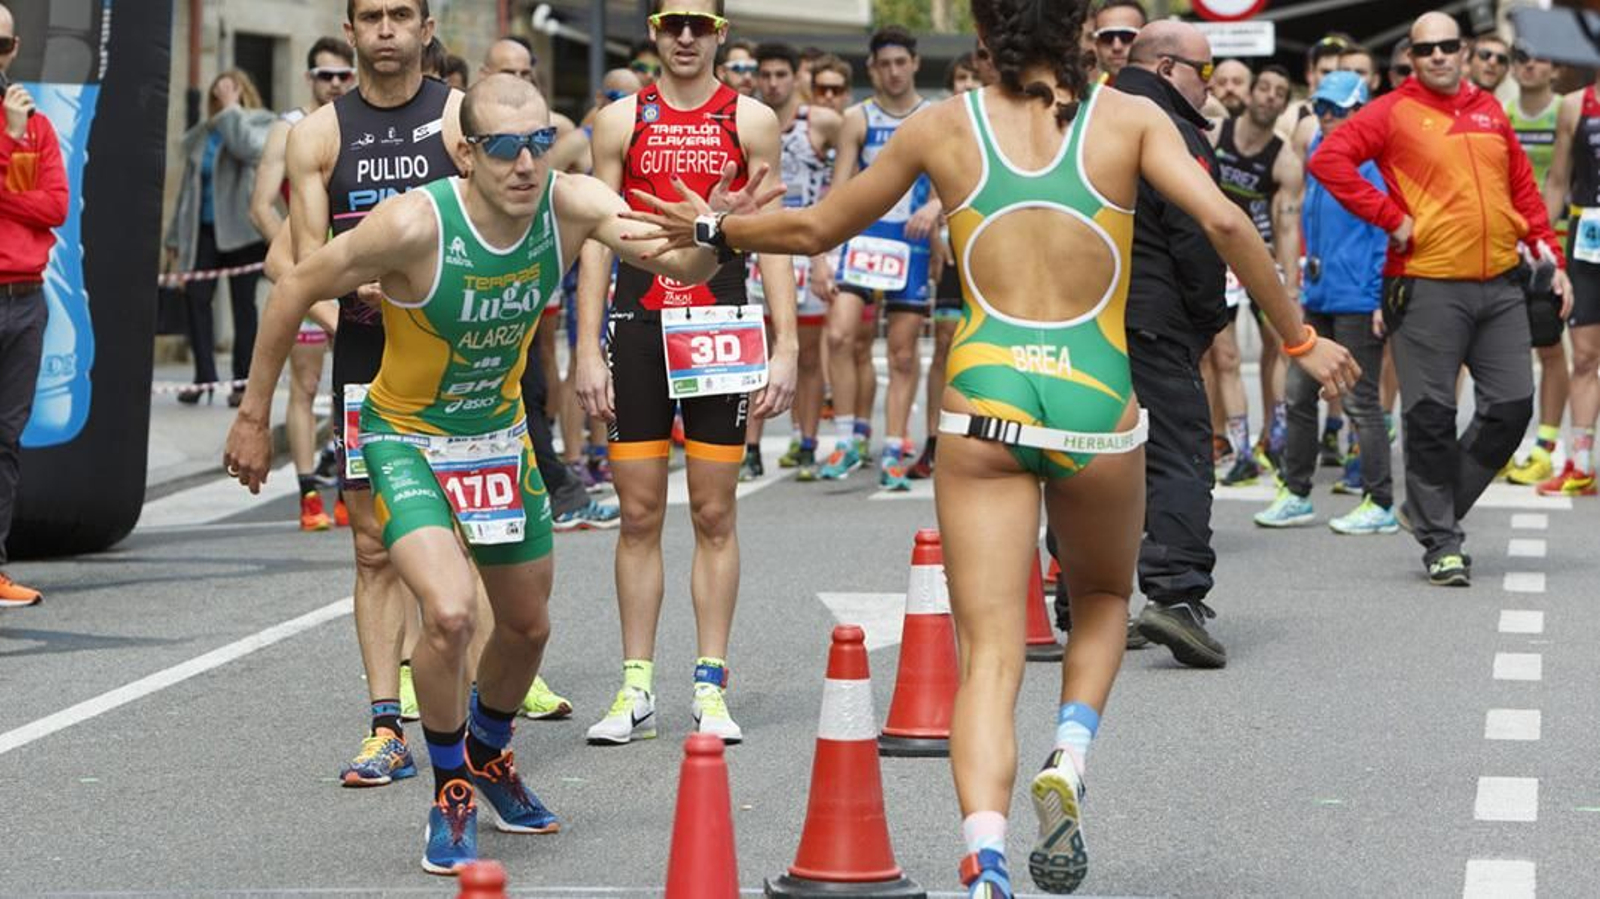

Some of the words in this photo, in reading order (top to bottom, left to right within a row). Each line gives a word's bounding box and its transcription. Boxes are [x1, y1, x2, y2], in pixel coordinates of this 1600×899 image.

[357, 154, 429, 183] PULIDO
[640, 145, 728, 175] GUTIÉRREZ
[855, 252, 900, 277] 21D
[458, 284, 541, 322] Lugo
[458, 322, 526, 350] ALARZA
[690, 334, 741, 364] 3D
[1010, 344, 1073, 377] BREA
[1063, 434, 1135, 450] HERBALIFE
[446, 473, 514, 509] 17D
